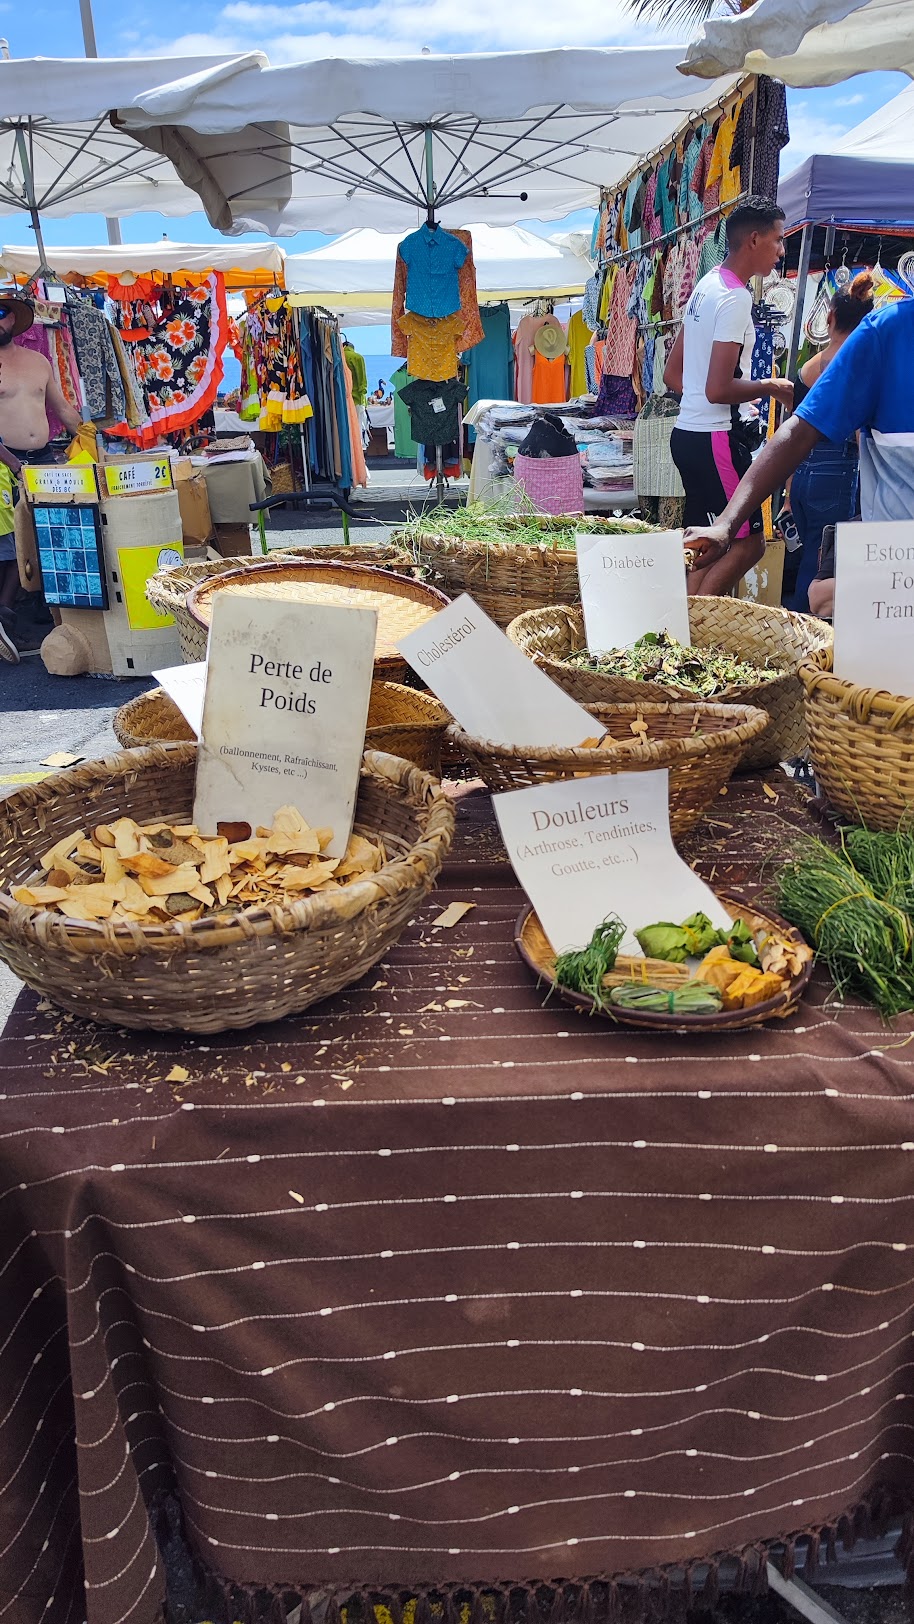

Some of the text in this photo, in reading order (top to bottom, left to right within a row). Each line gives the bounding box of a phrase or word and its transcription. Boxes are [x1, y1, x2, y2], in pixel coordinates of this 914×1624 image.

[119, 465, 167, 481] CAFÉ 2€
[602, 555, 655, 570] Diabète
[890, 571, 914, 590] Fo
[872, 601, 914, 619] Tran
[416, 616, 477, 668] Cholestérol
[248, 653, 333, 684] Perte de
[259, 687, 316, 715] Poids
[219, 745, 282, 763] (ballonnement,
[251, 761, 281, 776] Kystes,
[530, 799, 630, 832] Douleurs
[516, 821, 658, 862] (Arthrose, Tendinites,
[551, 845, 640, 877] Goutte, etc...)
